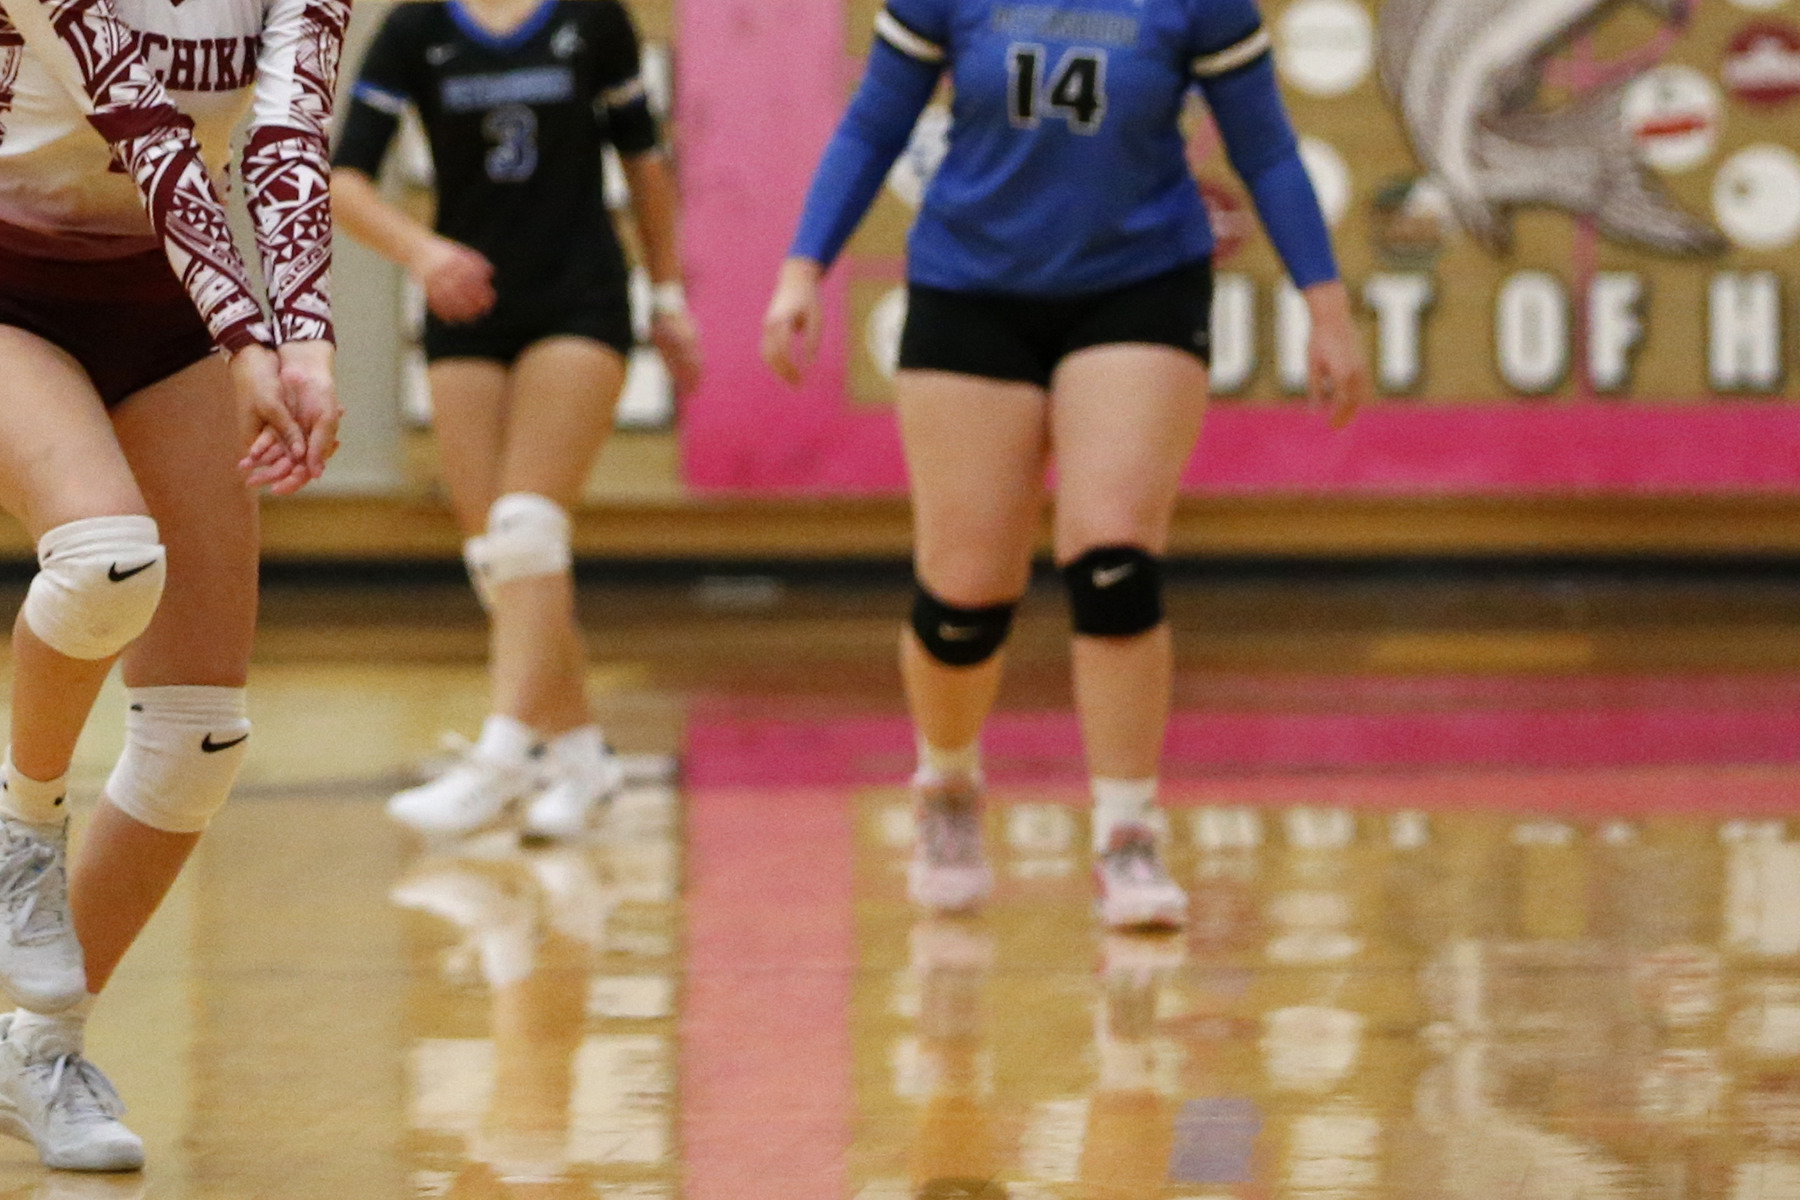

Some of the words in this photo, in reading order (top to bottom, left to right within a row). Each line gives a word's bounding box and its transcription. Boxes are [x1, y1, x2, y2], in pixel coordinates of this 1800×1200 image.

[1005, 41, 1109, 137] 14
[481, 102, 540, 184] 3
[1496, 268, 1646, 396] OF
